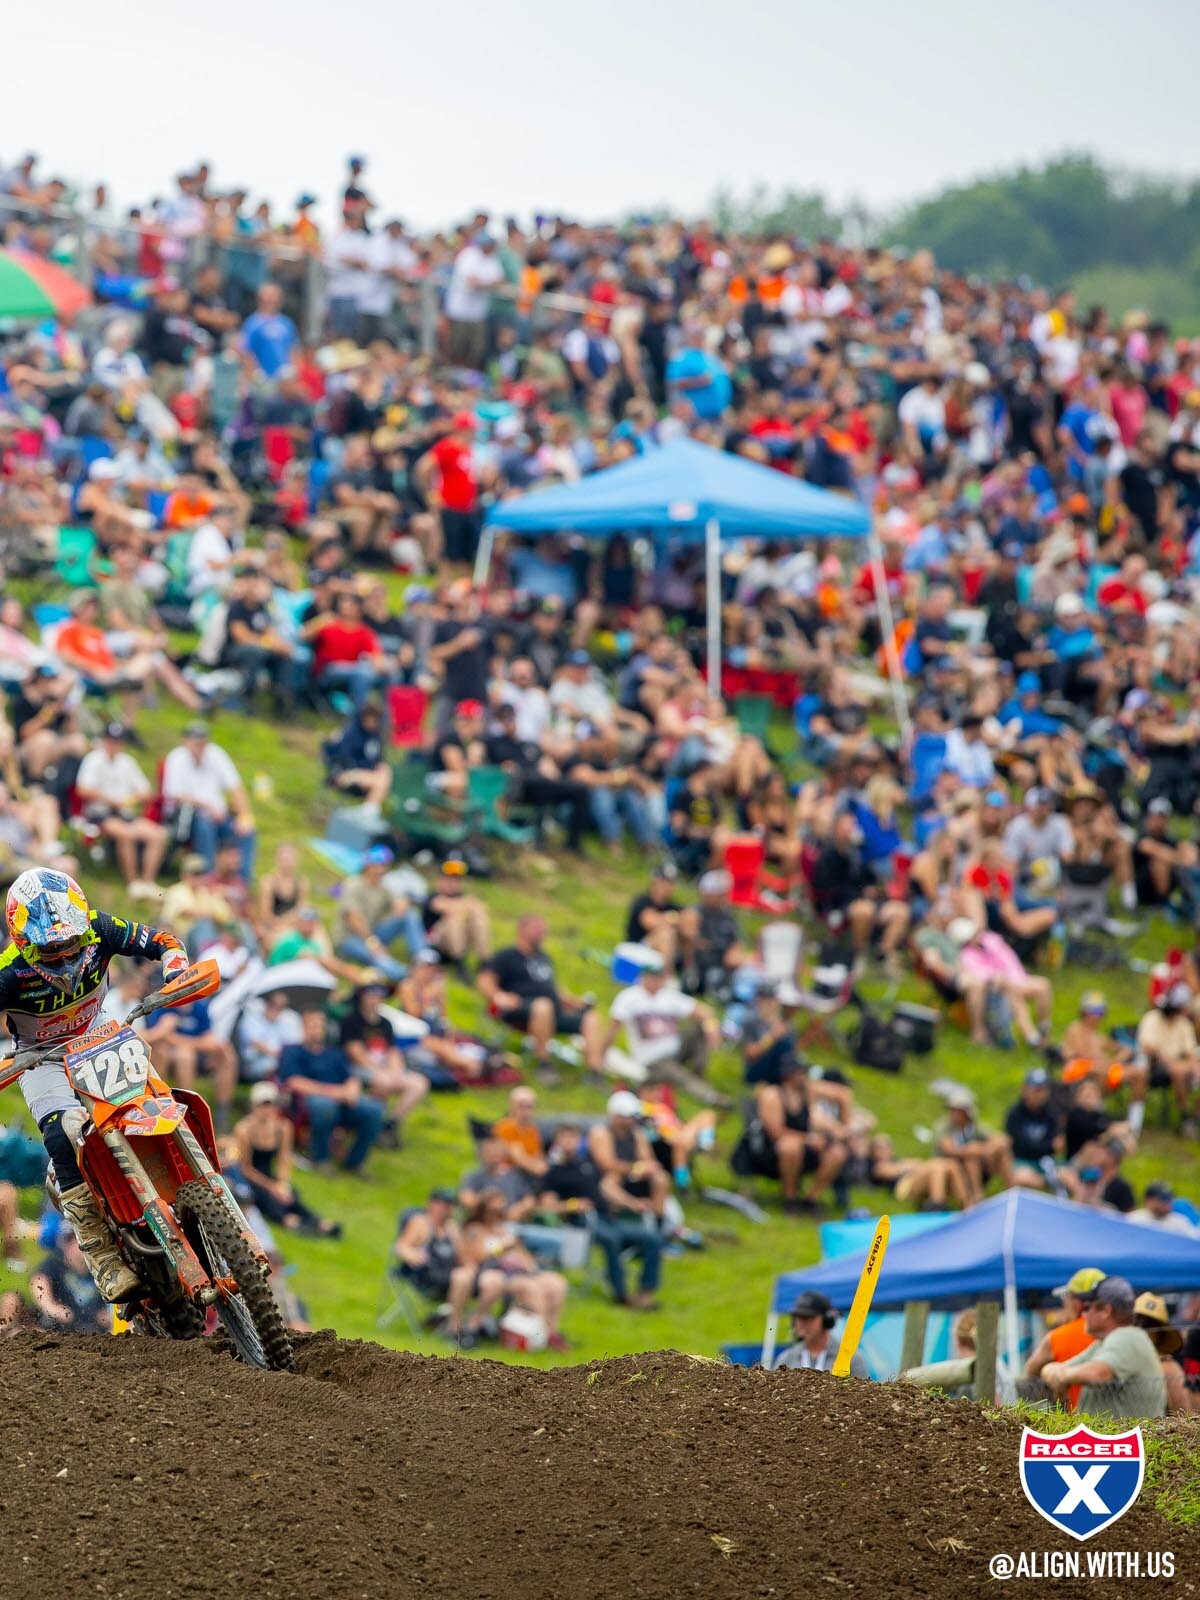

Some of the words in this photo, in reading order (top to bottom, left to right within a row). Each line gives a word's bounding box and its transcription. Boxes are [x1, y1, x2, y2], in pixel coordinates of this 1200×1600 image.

[178, 968, 199, 985] KTM
[36, 1022, 71, 1038] Red
[75, 1040, 149, 1099] 128
[867, 1234, 883, 1276] ACERBIS
